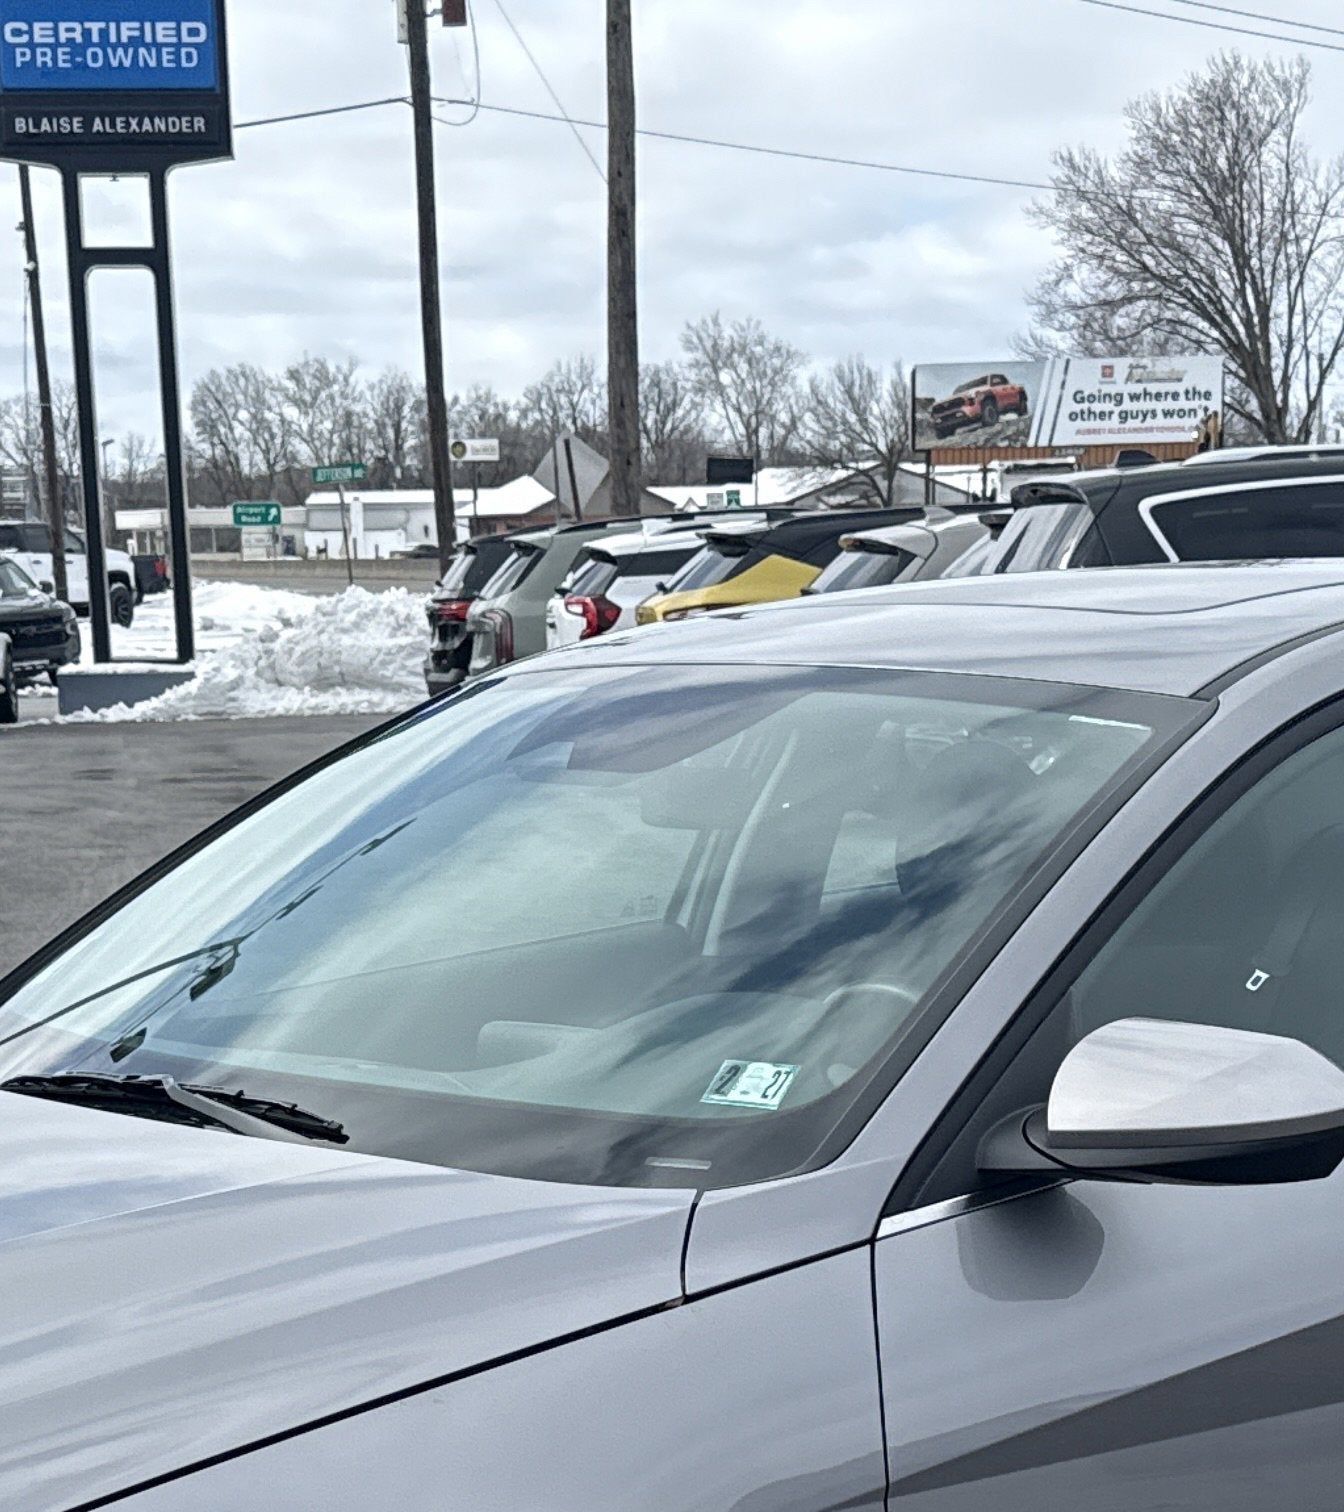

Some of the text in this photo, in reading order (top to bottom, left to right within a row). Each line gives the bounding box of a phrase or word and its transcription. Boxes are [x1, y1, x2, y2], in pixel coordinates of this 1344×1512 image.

[3, 21, 207, 44] CERTIFIED
[15, 46, 199, 68] PRE-OWNED
[14, 115, 206, 134] BLAISE ALEXANDER
[1072, 386, 1212, 406] Going where the
[1068, 404, 1209, 424] other guys won't
[760, 1069, 792, 1100] 27
